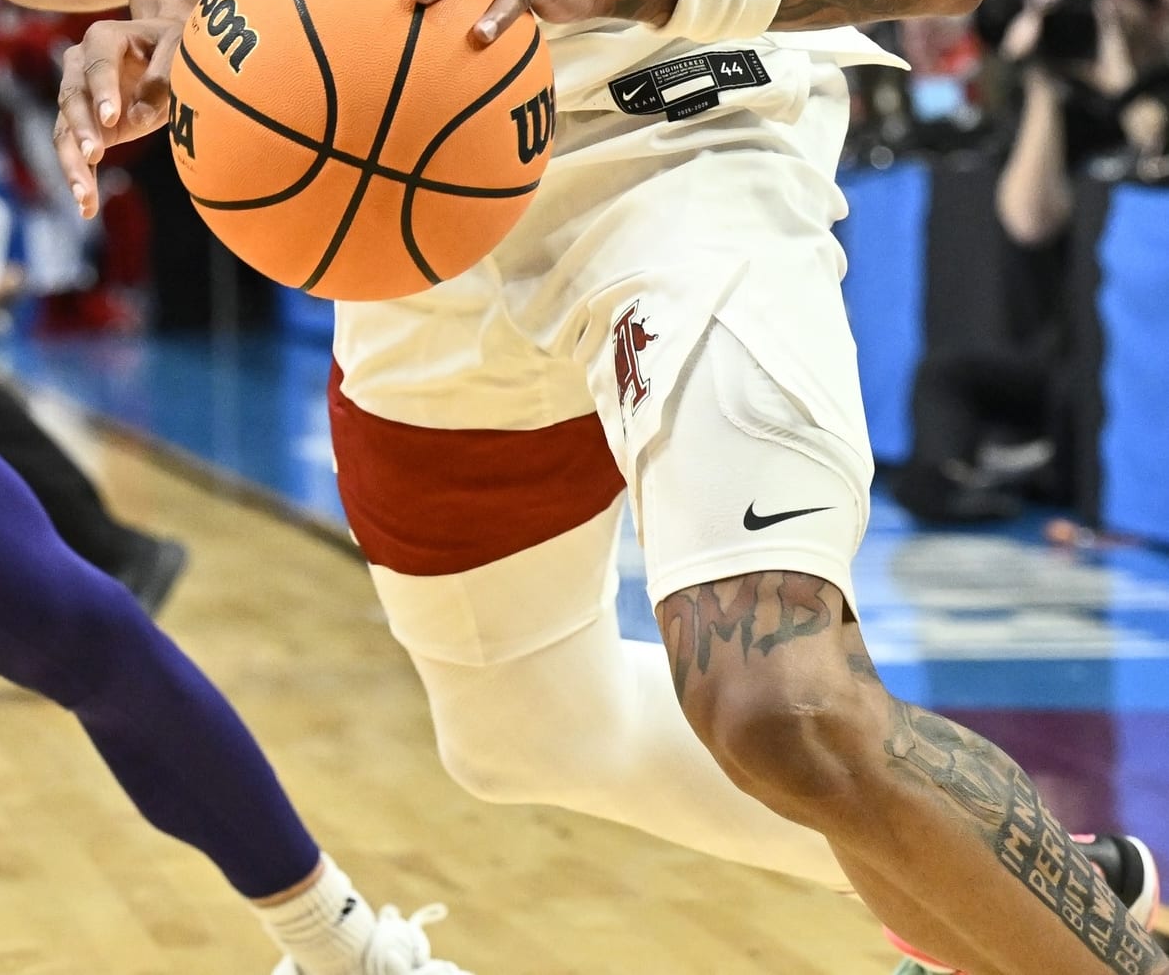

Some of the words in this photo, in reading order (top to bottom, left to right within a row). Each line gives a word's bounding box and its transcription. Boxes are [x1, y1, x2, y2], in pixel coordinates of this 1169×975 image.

[654, 58, 705, 76] ENGINEERED
[720, 61, 743, 76] 44
[1061, 870, 1089, 931] BUT
